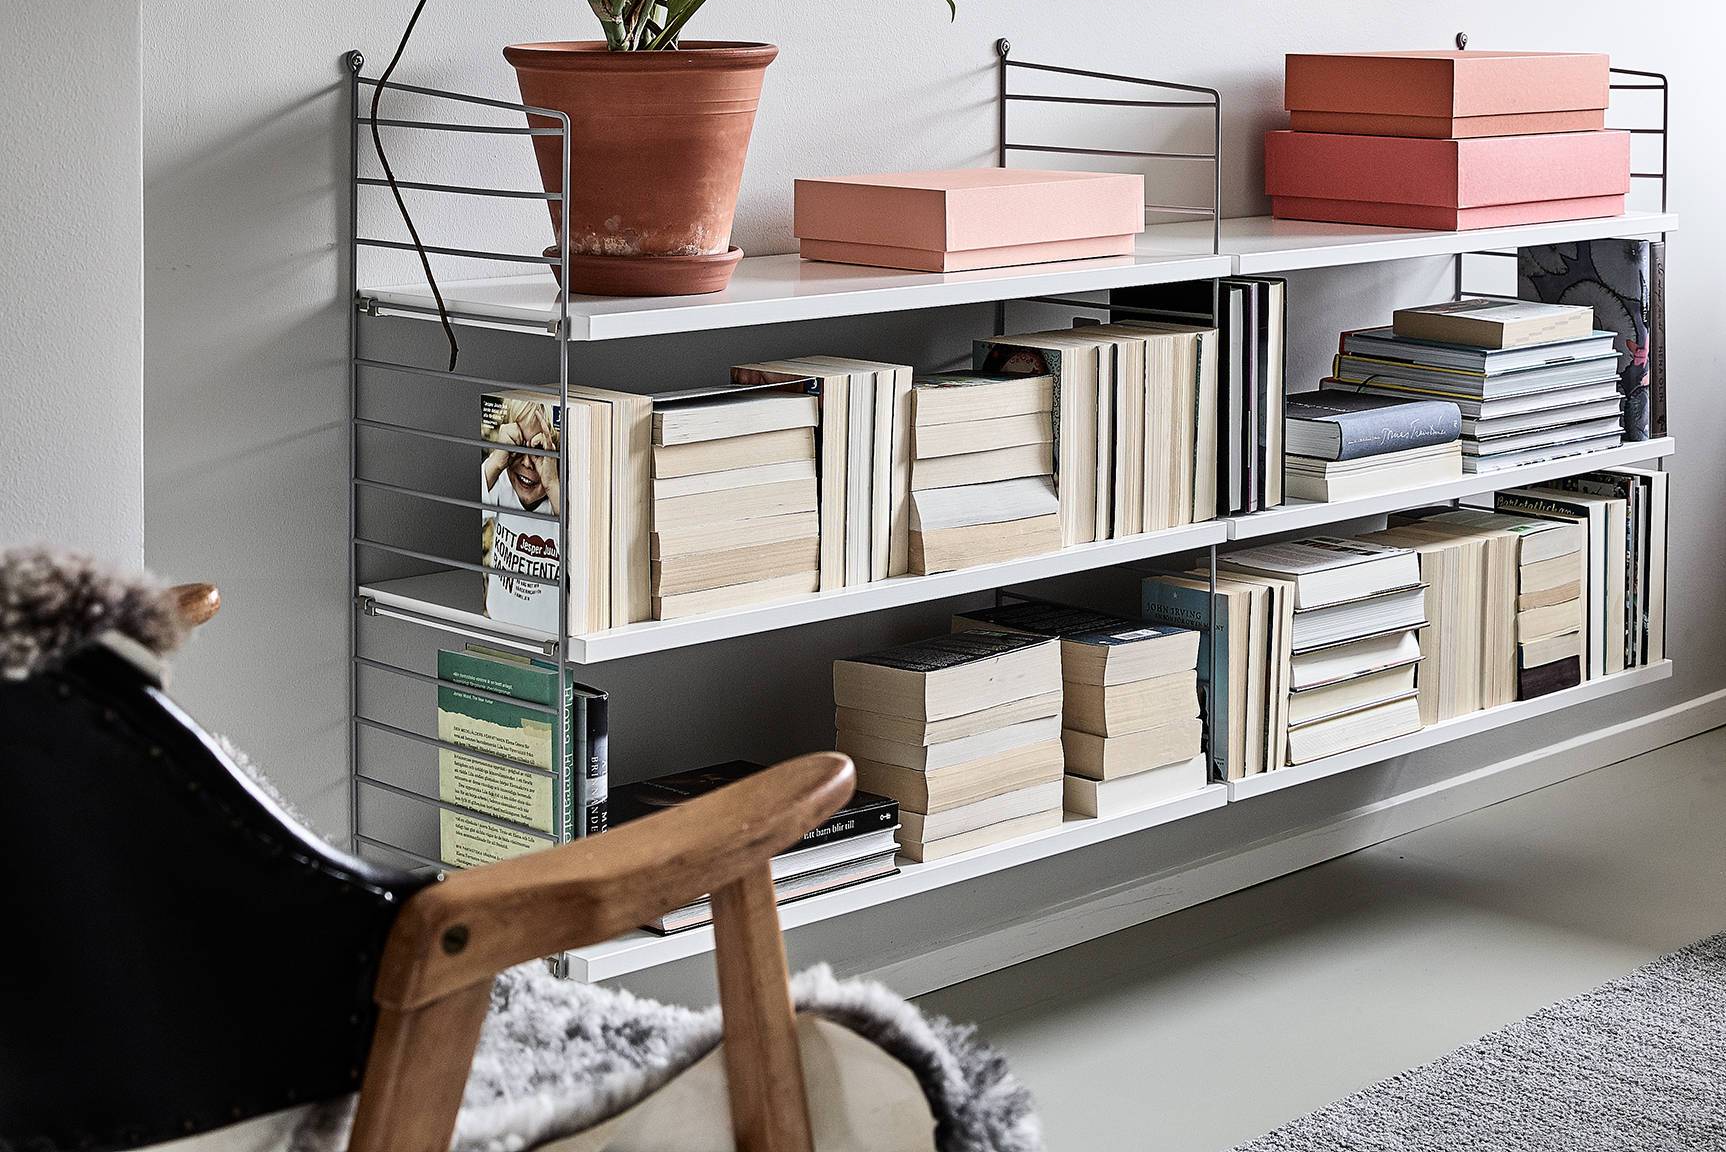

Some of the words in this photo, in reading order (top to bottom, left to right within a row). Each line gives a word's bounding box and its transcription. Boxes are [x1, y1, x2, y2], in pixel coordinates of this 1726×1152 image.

[497, 523, 517, 548] DITT
[520, 538, 542, 555] Jesper
[495, 536, 560, 581] KOMPETENTA
[1146, 602, 1169, 615] JOHN
[1171, 607, 1202, 621] IRVING
[590, 756, 599, 832] BRINNANDE
